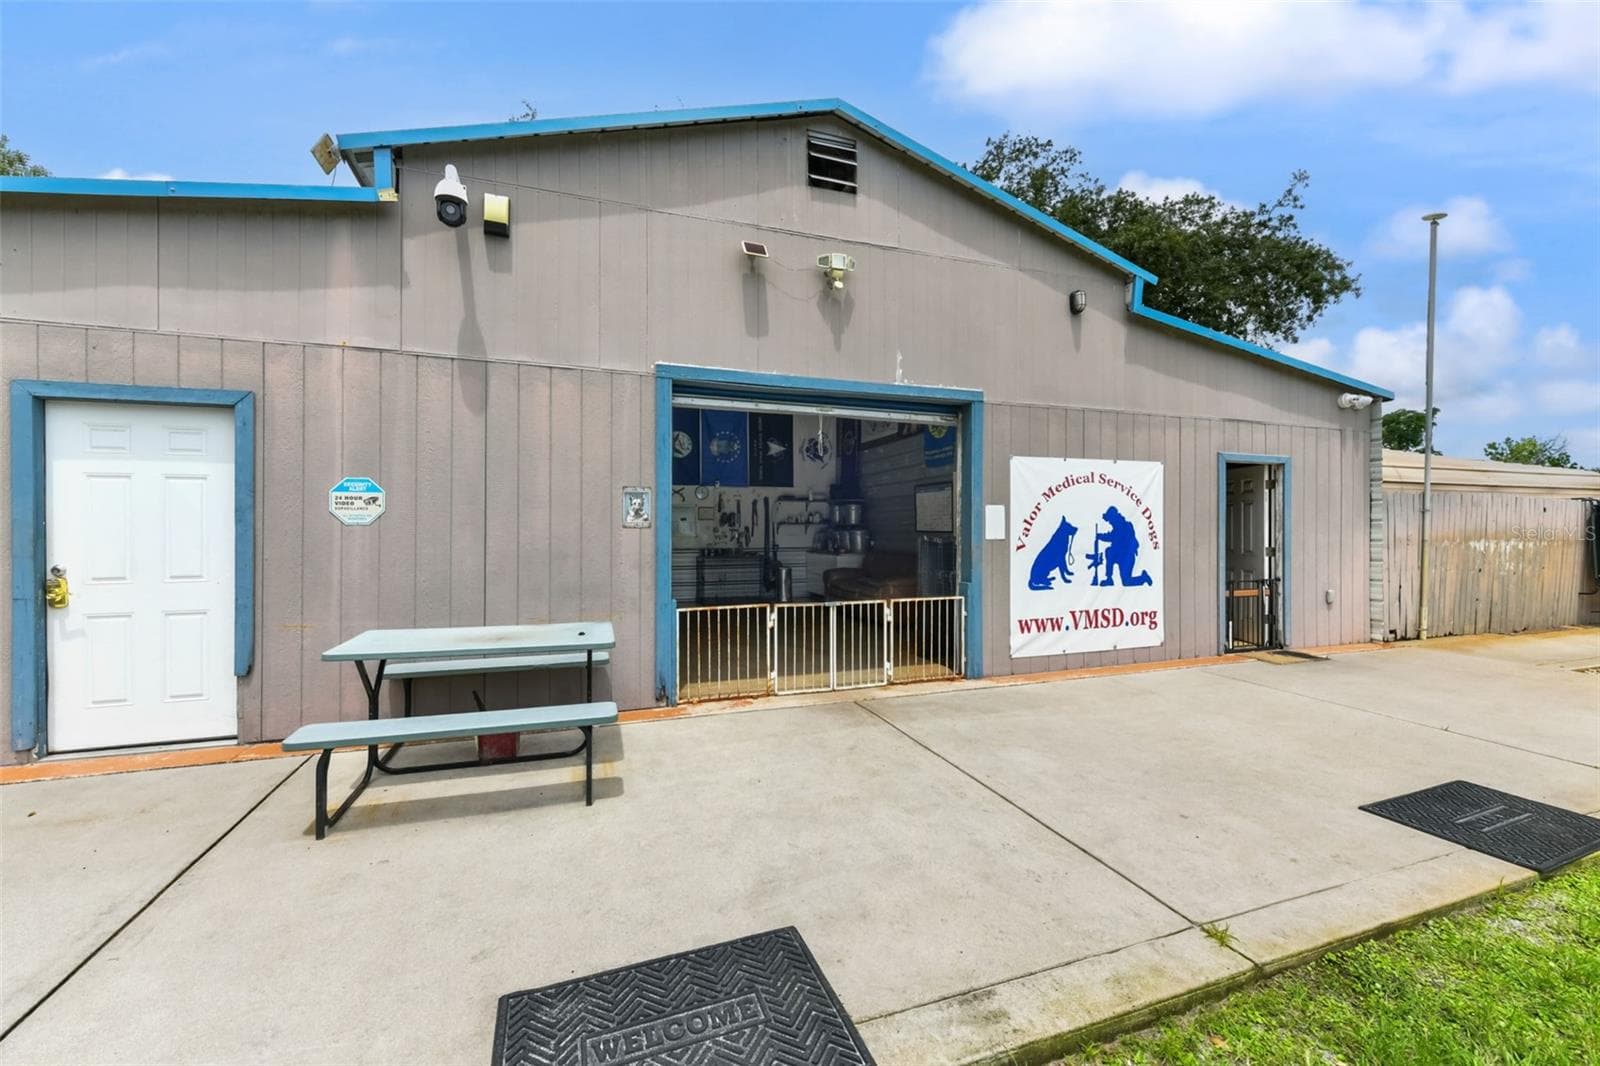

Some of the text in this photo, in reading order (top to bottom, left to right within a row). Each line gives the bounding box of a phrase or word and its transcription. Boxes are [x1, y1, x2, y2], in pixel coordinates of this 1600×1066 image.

[1015, 472, 1160, 552] Valor Medical Service Dogs
[1017, 607, 1158, 634] www.VMSD.org
[589, 999, 760, 1064] WELCOME
